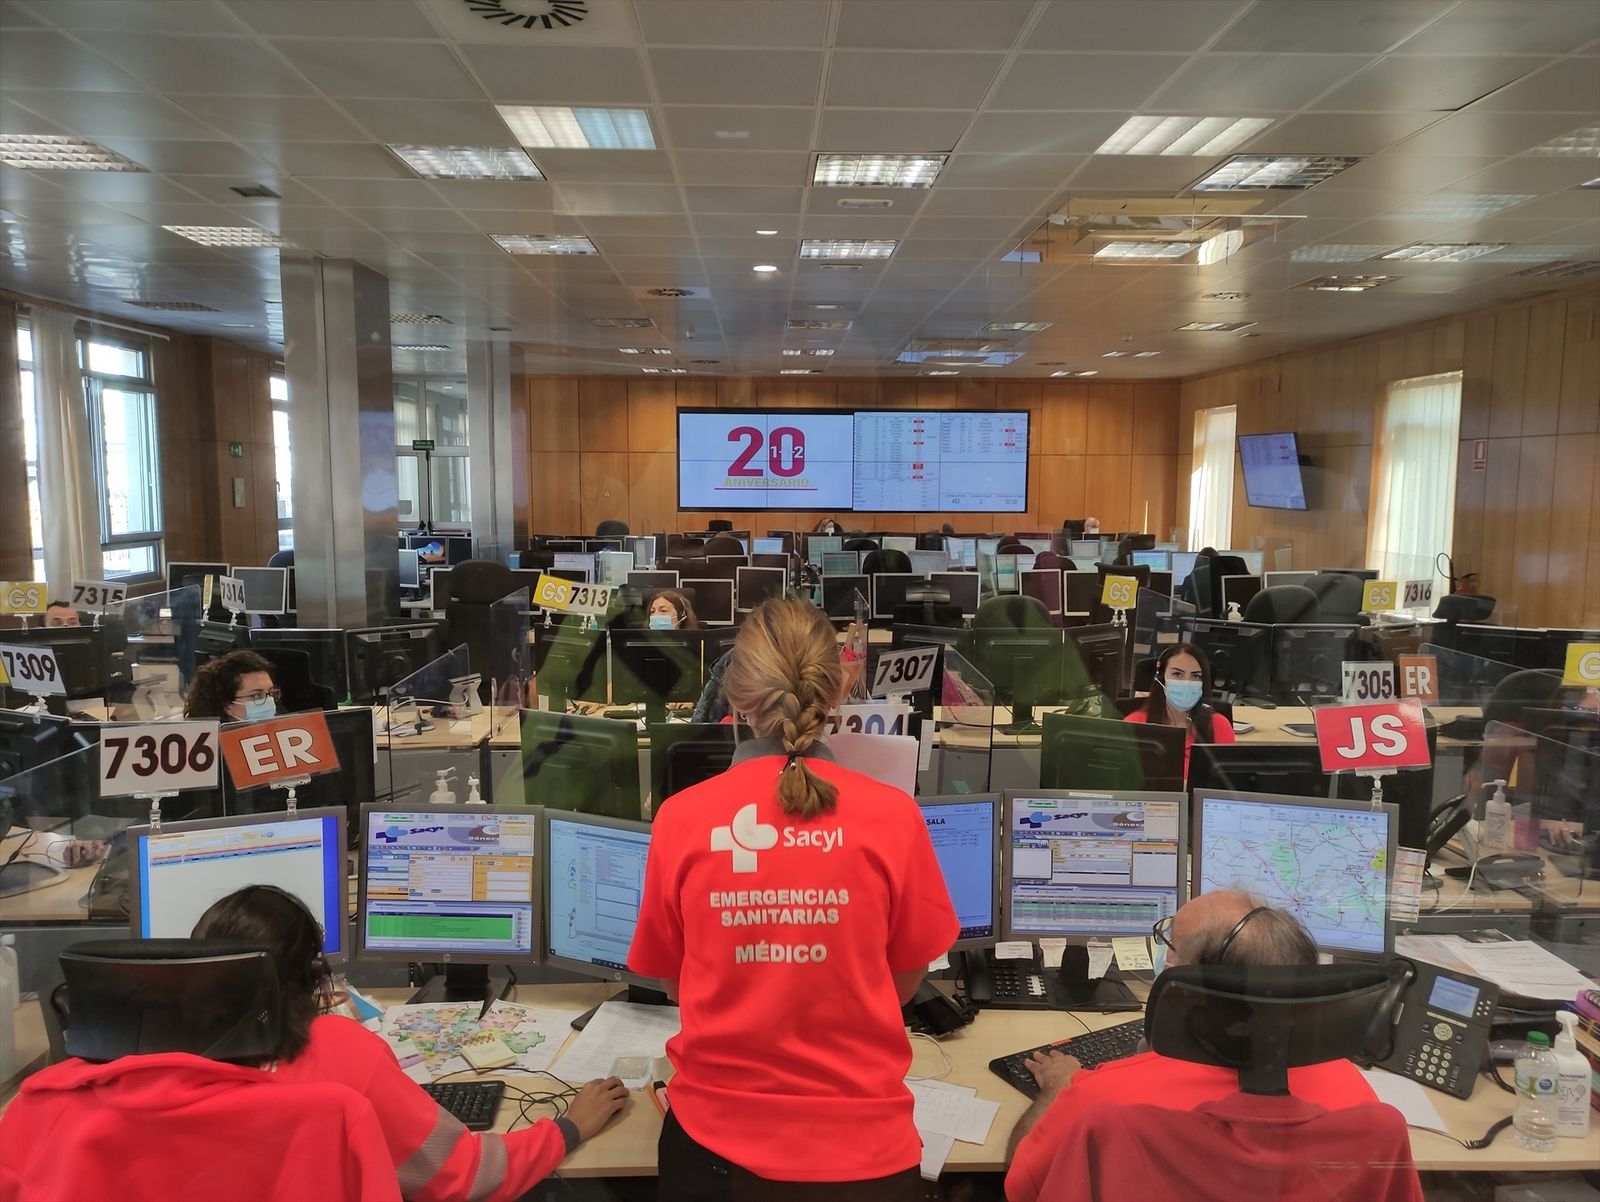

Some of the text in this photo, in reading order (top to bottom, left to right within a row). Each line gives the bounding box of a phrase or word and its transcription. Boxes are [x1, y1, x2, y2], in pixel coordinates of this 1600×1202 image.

[727, 426, 805, 477] 20
[724, 478, 809, 488] ANIVERSARIO
[8, 588, 40, 608] GS
[73, 585, 123, 606] 7315
[220, 581, 245, 604] 7314
[541, 581, 609, 608] GS 7313
[1110, 582, 1131, 602] GS
[1369, 583, 1432, 606] GS 7316
[2, 650, 56, 682] 7309
[875, 654, 935, 687] 7307
[1344, 665, 1433, 700] 7305 ER
[1335, 713, 1409, 759] JS
[104, 727, 321, 780] 7306 ER
[926, 818, 946, 826] SALA
[782, 826, 844, 853] Sacyl
[709, 888, 850, 908] EMERGENCIAS
[720, 908, 840, 928] SANITARIAS
[735, 940, 828, 964] MÉDICO
